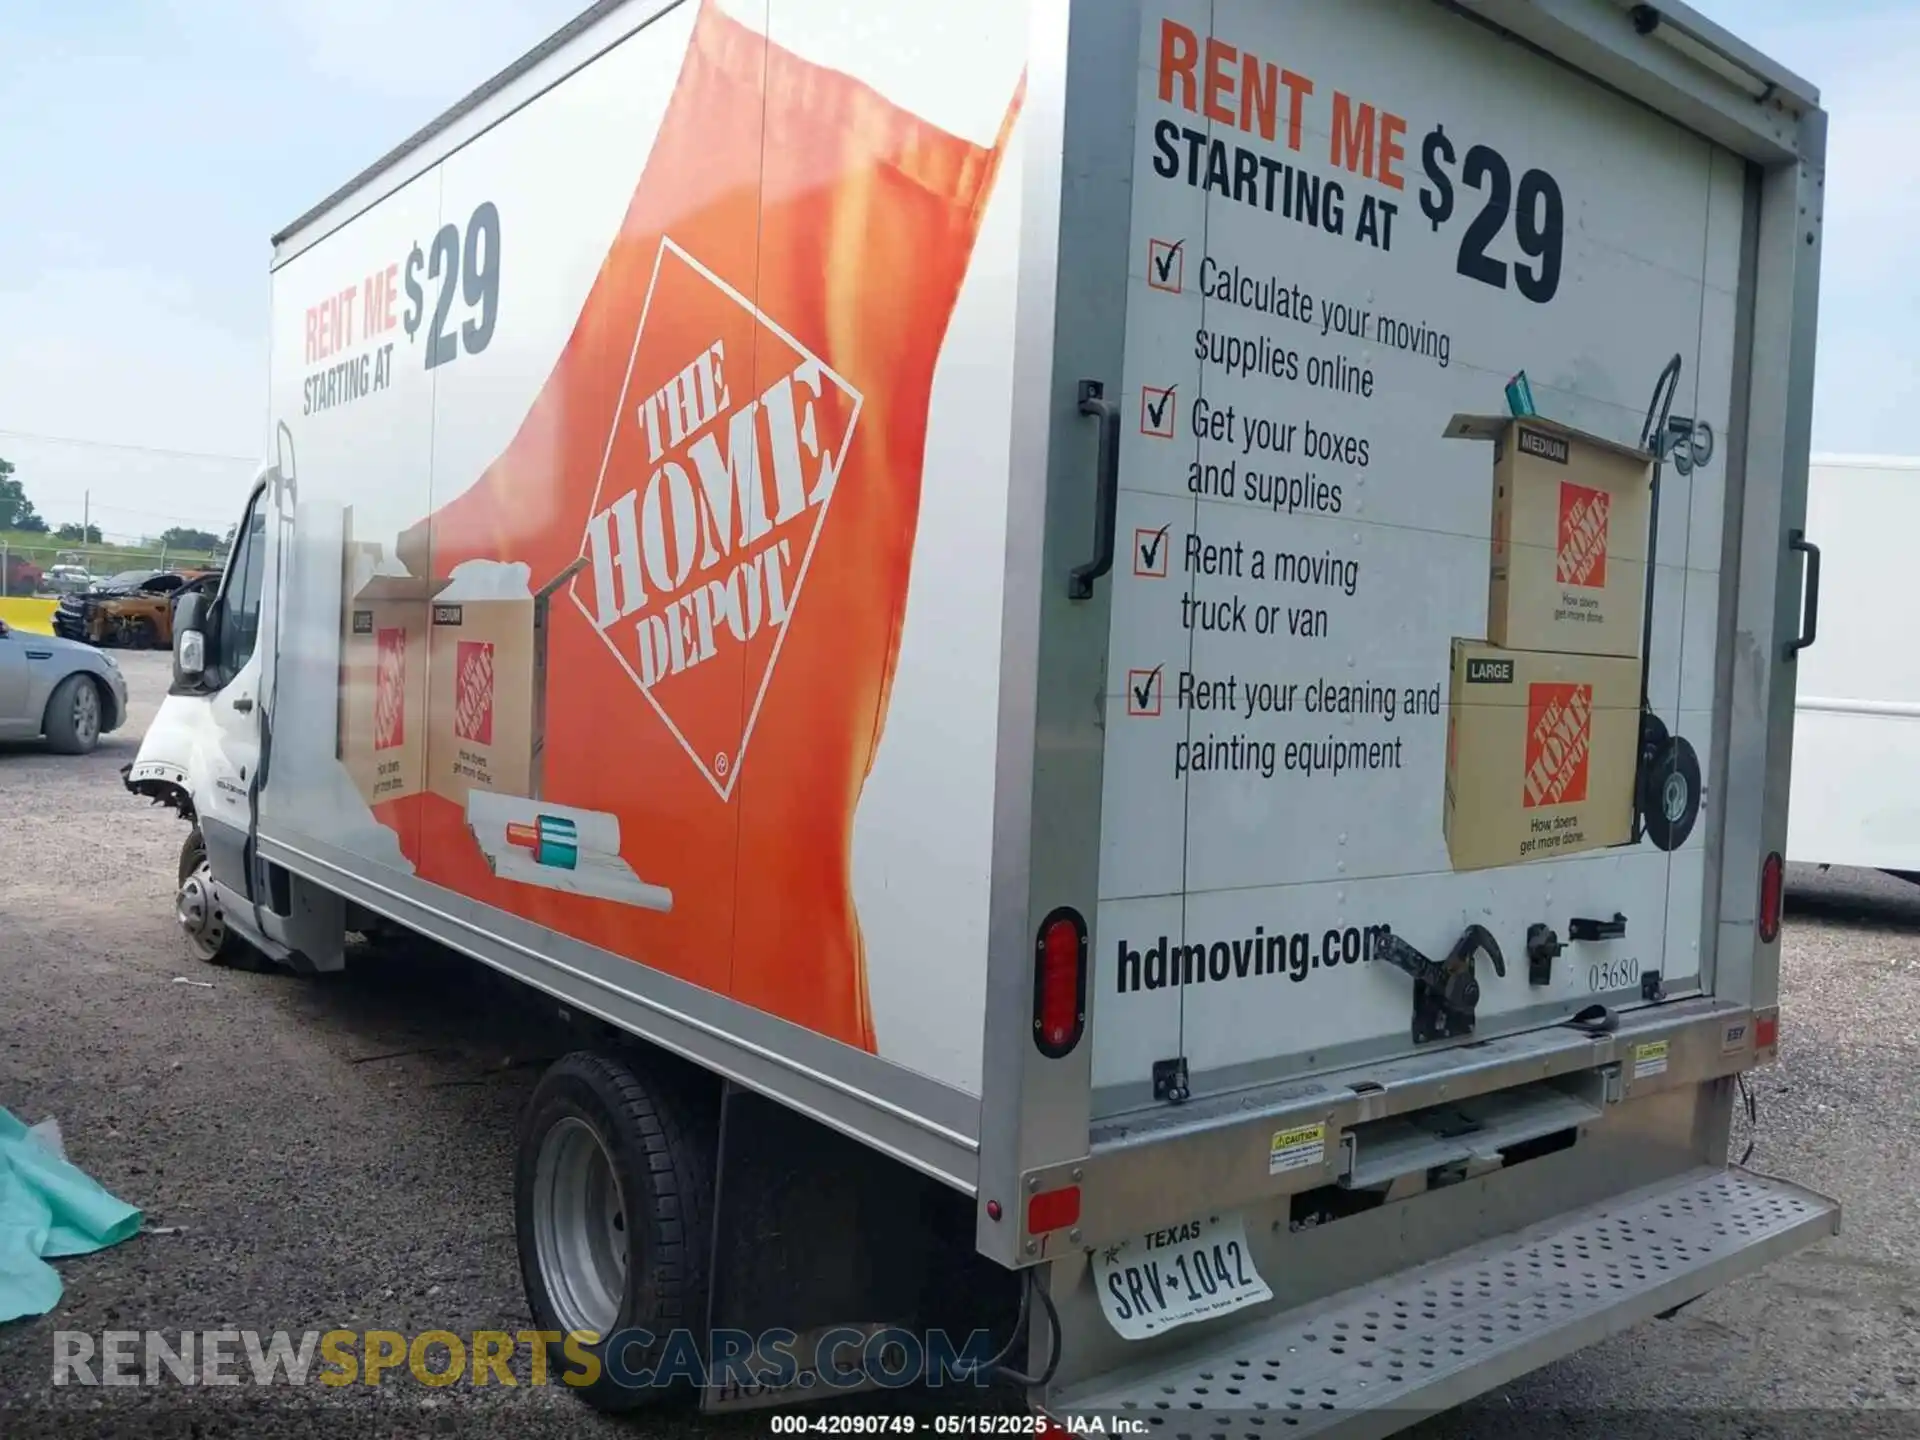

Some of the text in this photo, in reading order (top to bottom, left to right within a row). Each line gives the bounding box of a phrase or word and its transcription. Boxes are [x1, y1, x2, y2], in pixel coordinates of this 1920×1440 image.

[1158, 18, 1407, 191] RENT ME
[1153, 119, 1398, 251] STARTING AT
[1419, 123, 1564, 304] $29
[305, 264, 398, 365] RENT ME
[403, 201, 500, 370] $29
[1199, 256, 1450, 368] Calculate your moving
[303, 344, 394, 416] STARTING AT
[1194, 328, 1374, 398] supplies online
[638, 338, 730, 465] THE
[1191, 397, 1370, 467] Get your boxes
[1522, 431, 1565, 459] MEDIUM
[585, 359, 836, 630] HOME
[1188, 460, 1342, 514] and supplies
[1184, 533, 1359, 596] Rent a moving
[636, 537, 792, 691] DEPOT
[1181, 592, 1327, 638] truck or van
[1178, 671, 1440, 722] Rent your cleaning and
[1471, 663, 1510, 678] LARGE
[1524, 684, 1592, 806] HOME
[1534, 696, 1562, 744] THE
[1175, 733, 1403, 780] painting equipment
[1520, 839, 1536, 855] get
[1537, 835, 1560, 849] more
[1531, 815, 1577, 832] How doers
[1589, 958, 1639, 992] 03680
[1285, 1129, 1319, 1144] CAUTION
[1144, 1220, 1201, 1251] TEXAS
